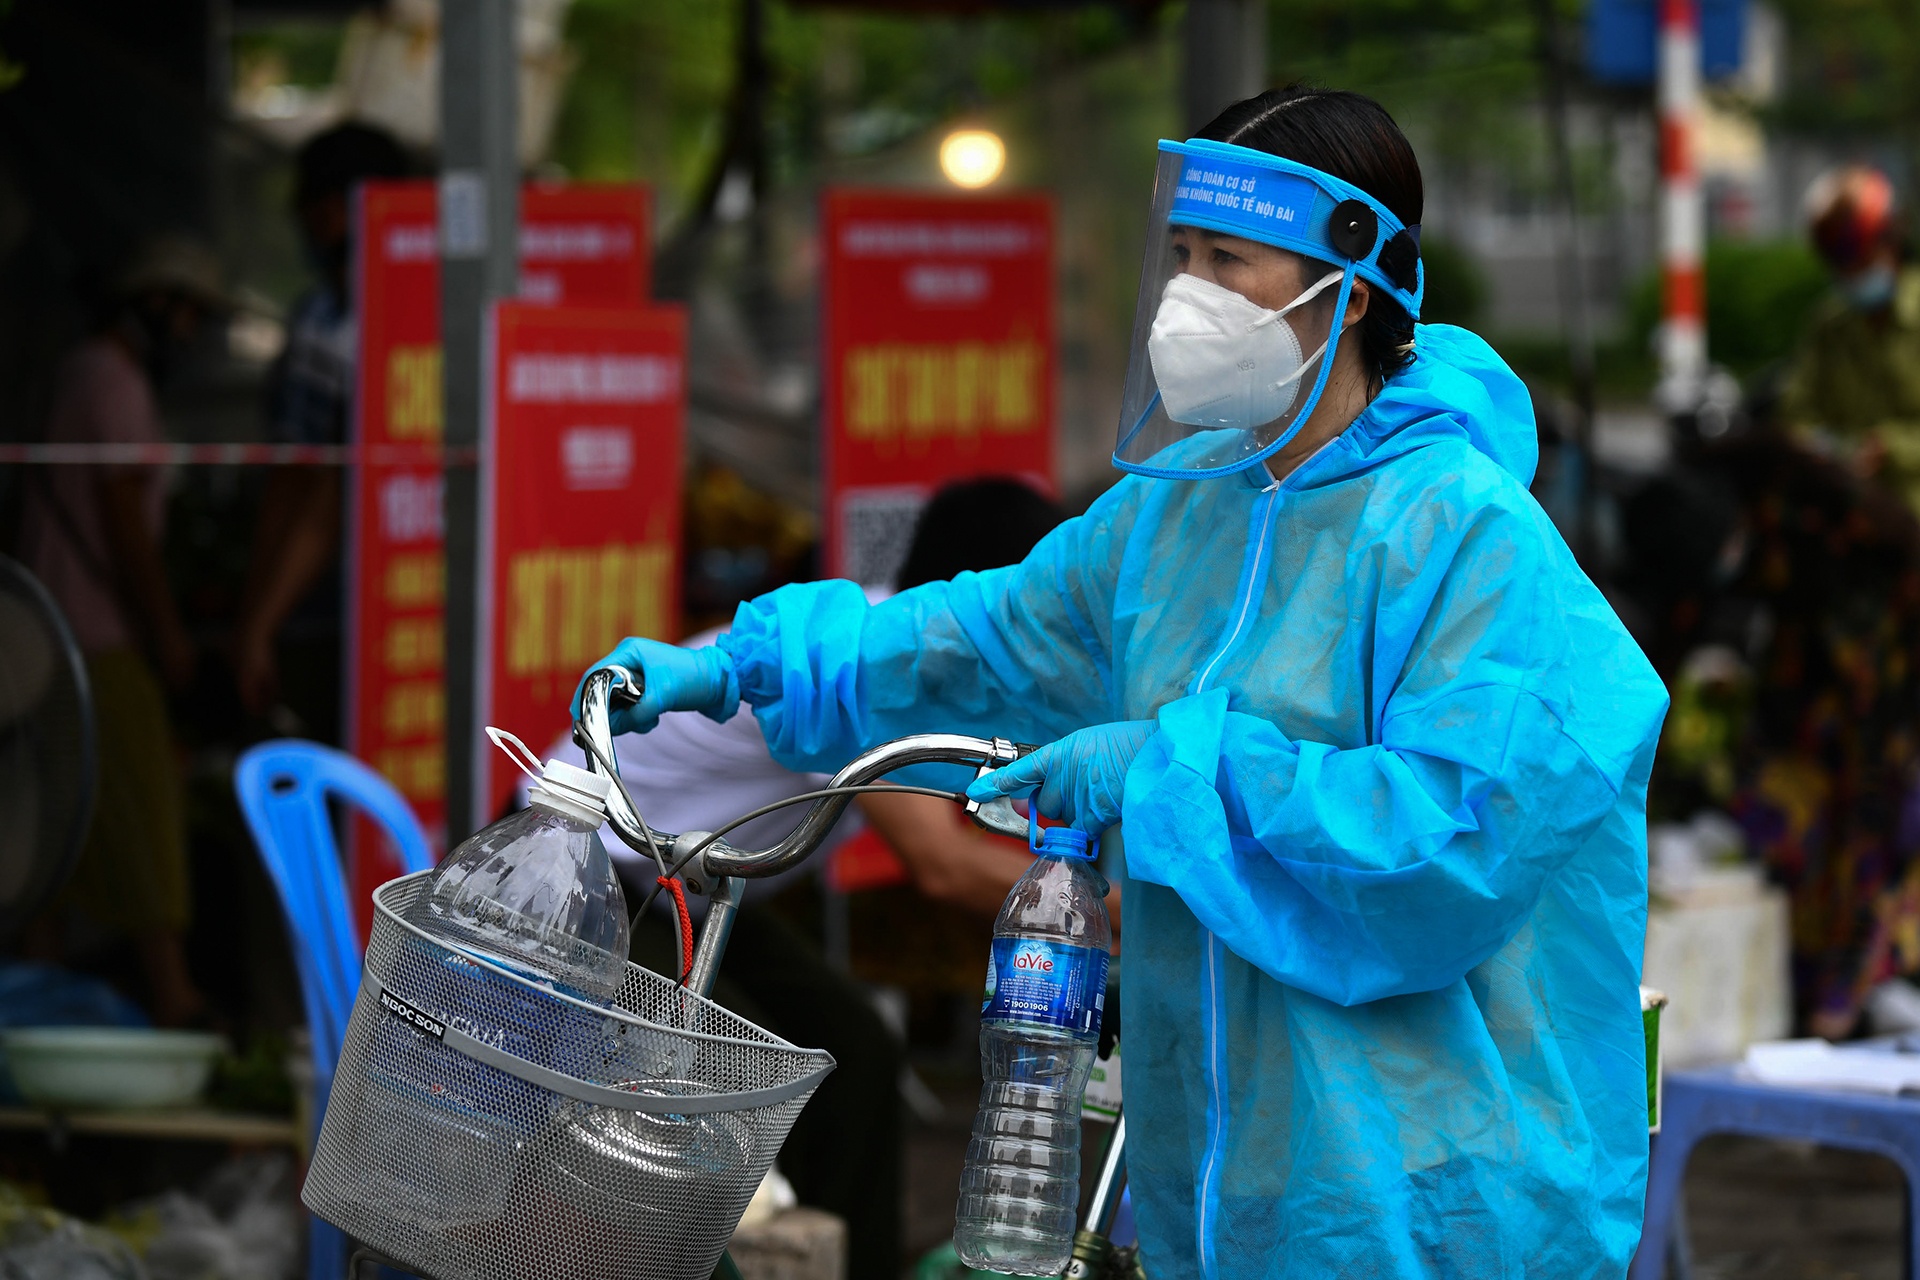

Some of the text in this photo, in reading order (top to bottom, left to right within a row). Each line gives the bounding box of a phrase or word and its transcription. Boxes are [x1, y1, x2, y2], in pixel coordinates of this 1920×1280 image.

[1202, 171, 1224, 187] ĐOÀN
[1226, 175, 1240, 189] CƠ
[1241, 177, 1256, 193] SỞ
[1190, 186, 1214, 203] KHÔNG
[1215, 191, 1240, 208] QUỐC
[1243, 196, 1256, 211] TẾ
[1256, 201, 1275, 219] NỘI
[1013, 952, 1054, 972] laVie
[1011, 1000, 1029, 1009] 1900
[1030, 1003, 1049, 1012] 1906
